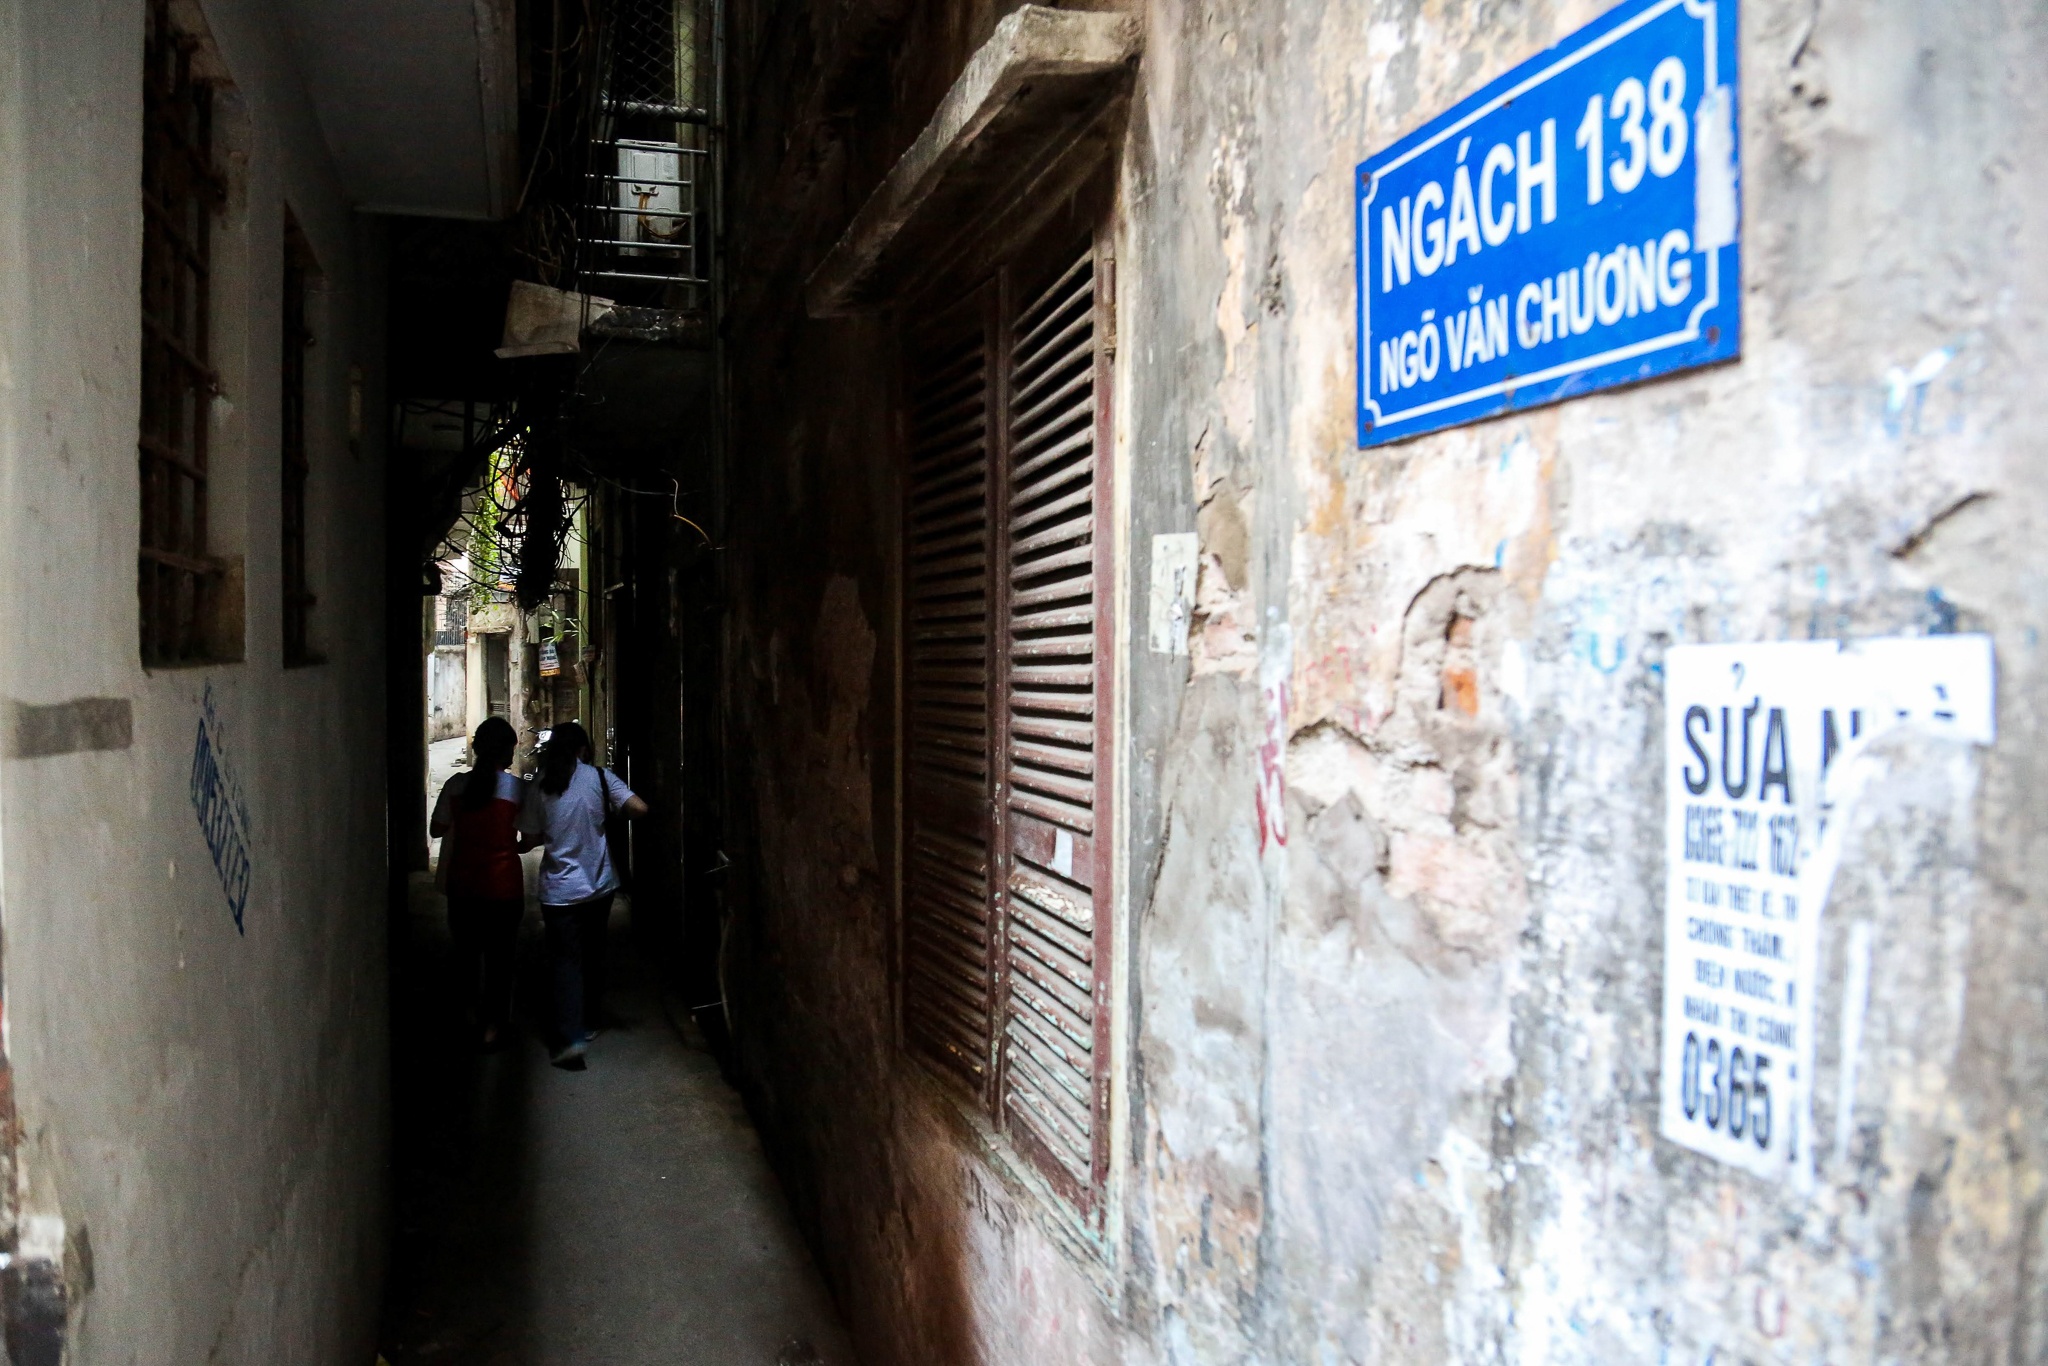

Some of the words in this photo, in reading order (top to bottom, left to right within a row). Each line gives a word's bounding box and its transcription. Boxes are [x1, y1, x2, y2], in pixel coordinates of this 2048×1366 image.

[1381, 117, 1557, 293] NGÁCH
[1576, 56, 1688, 205] 138
[1379, 308, 1440, 395] NGÕ
[1444, 285, 1508, 372] VĂN
[1516, 229, 1691, 349] CHƯƠNG
[1682, 661, 1794, 804] SỬA
[1681, 1031, 1772, 1150] 0365
